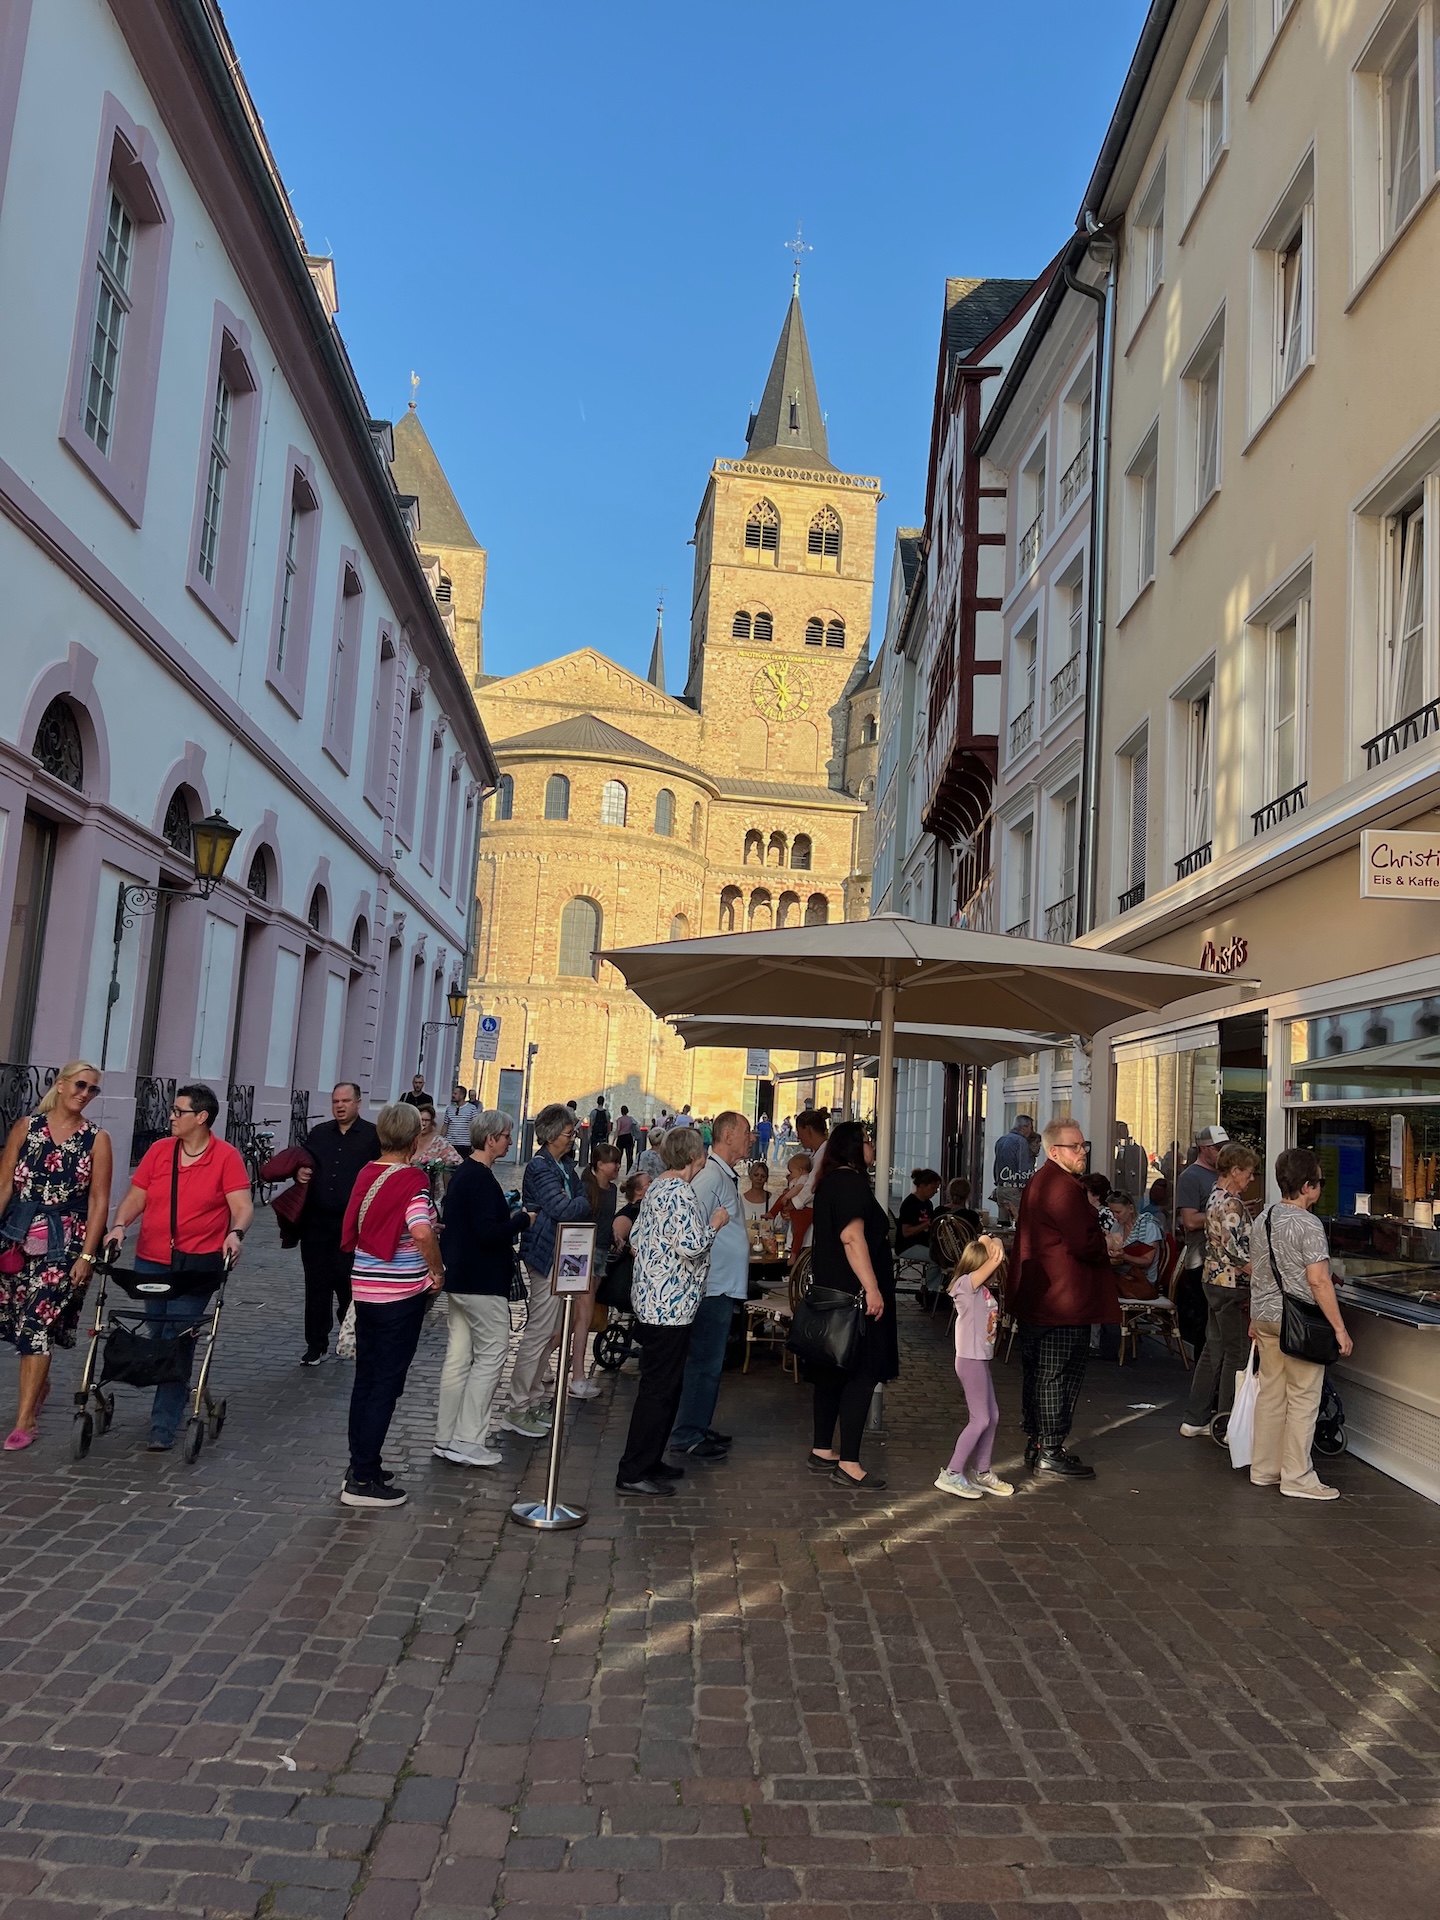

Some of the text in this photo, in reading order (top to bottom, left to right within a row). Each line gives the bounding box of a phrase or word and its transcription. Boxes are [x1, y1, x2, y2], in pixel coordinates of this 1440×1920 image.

[1373, 875, 1440, 887] Eis & Kaffe
